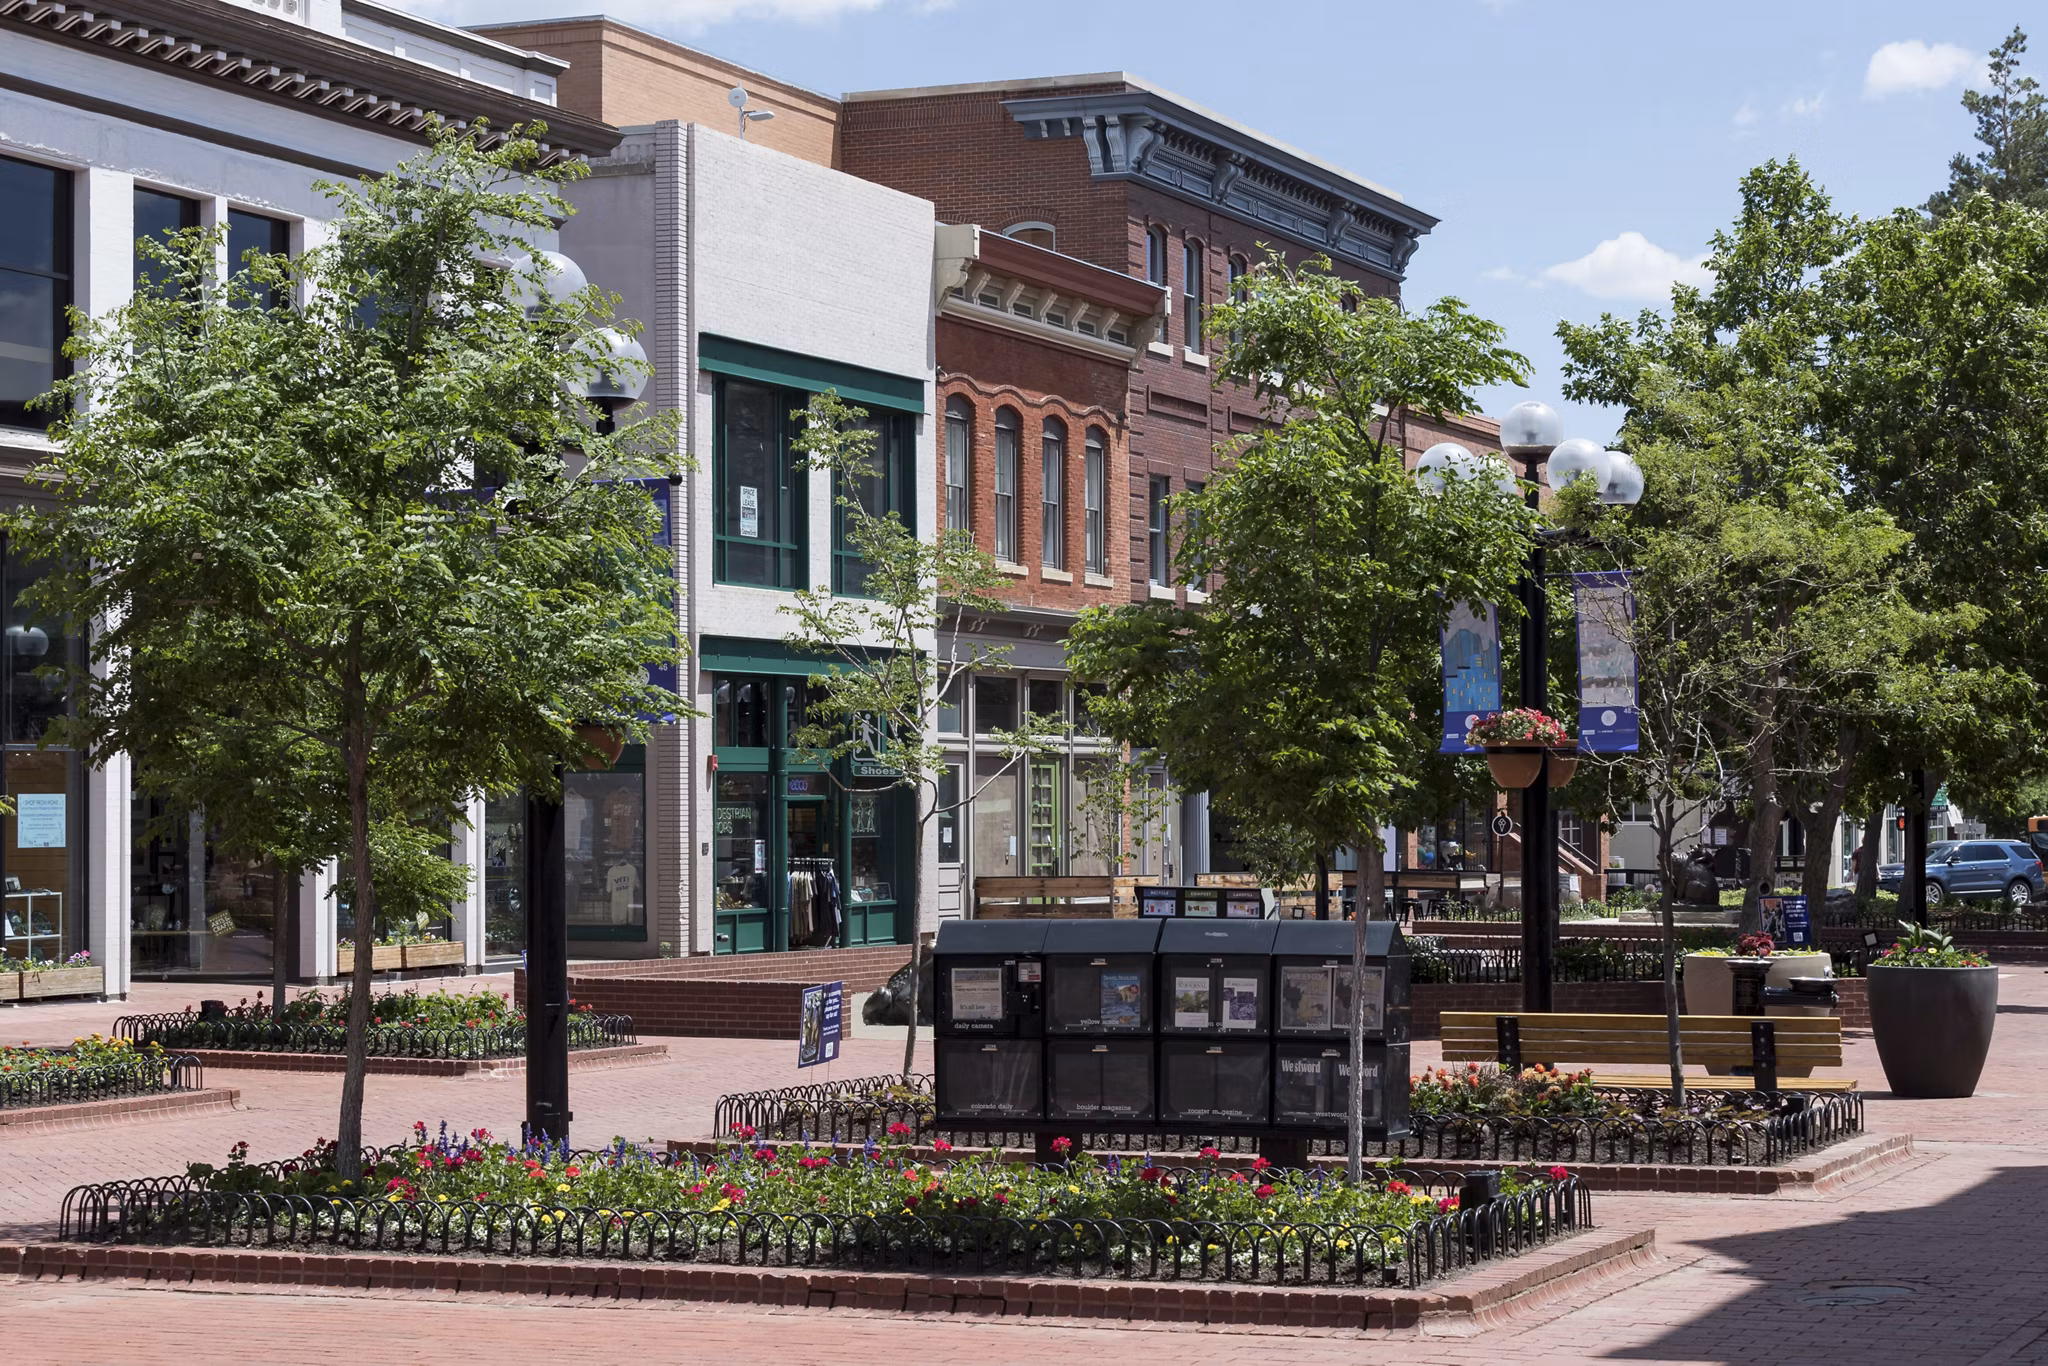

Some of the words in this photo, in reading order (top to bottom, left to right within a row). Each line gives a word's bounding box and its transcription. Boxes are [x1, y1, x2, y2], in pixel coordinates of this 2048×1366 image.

[742, 499, 755, 507] LEASE
[861, 766, 896, 775] Shoes
[717, 807, 752, 820] DESTRIAN
[954, 1022, 970, 1030] daily
[1080, 1018, 1100, 1026] yellow
[1338, 1064, 1378, 1077] Weord
[998, 1103, 1013, 1111] daily
